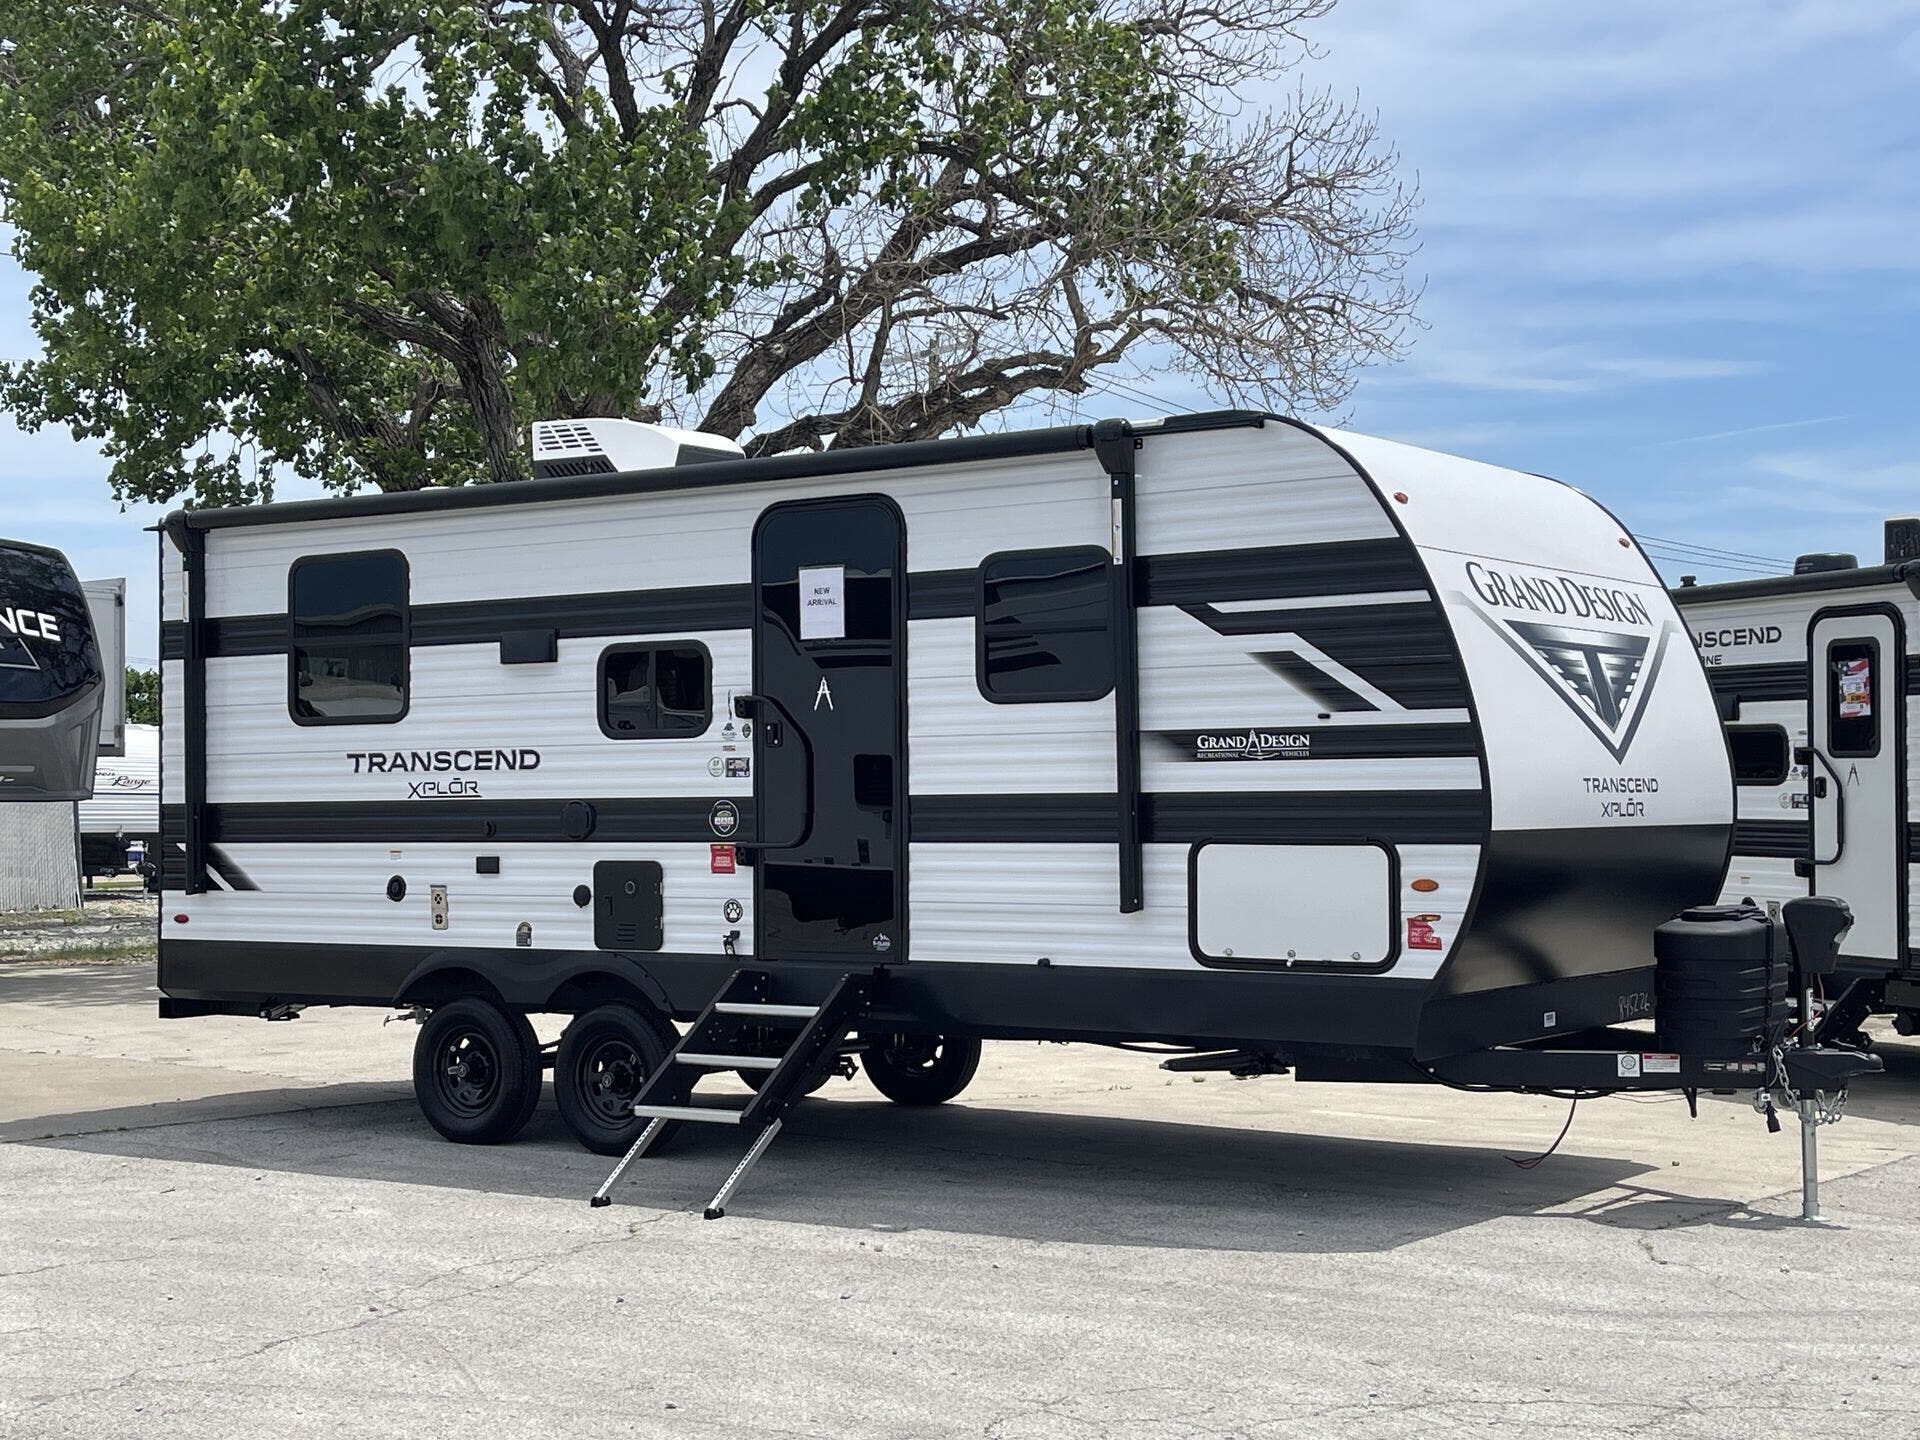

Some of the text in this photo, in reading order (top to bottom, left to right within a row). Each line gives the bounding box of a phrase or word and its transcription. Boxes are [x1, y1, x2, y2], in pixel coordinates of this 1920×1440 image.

[813, 586, 831, 595] NEW
[1465, 561, 1653, 626] GRAND DESIGN
[807, 597, 838, 607] ARRIVAL
[1196, 733, 1310, 749] GRAND DESIGN
[346, 749, 541, 773] TRANSCEND
[1583, 777, 1659, 793] TRANSCEND
